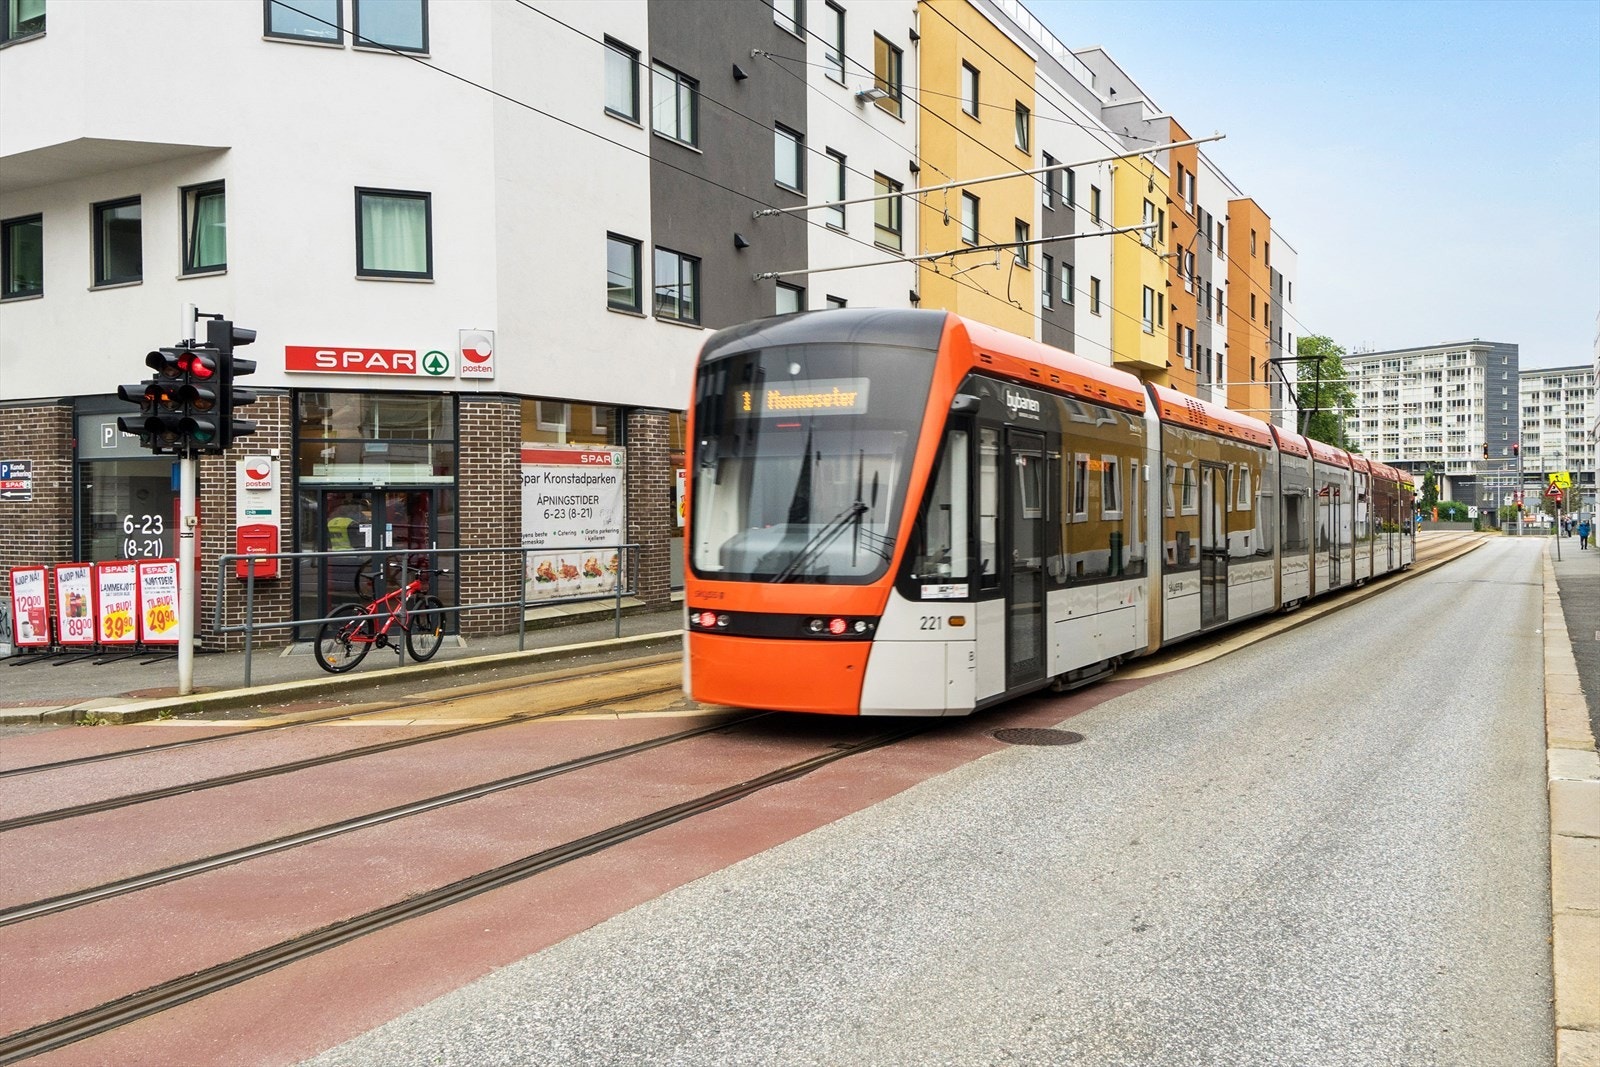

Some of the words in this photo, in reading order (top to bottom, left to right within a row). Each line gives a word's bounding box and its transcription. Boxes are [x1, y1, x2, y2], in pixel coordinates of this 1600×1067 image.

[315, 350, 414, 370] SPAR
[463, 365, 492, 373] posten
[1006, 389, 1040, 412] bybanen
[105, 428, 113, 443] P
[581, 454, 611, 463] SPAR
[2, 464, 8, 478] P
[543, 472, 616, 486] Kronstadparken
[536, 493, 600, 506] ÅPNINGSTIDER
[543, 509, 566, 519] 6-23
[569, 507, 593, 520] (8-21)
[123, 514, 164, 535] 6-23
[123, 538, 163, 558] (8-21)
[105, 566, 128, 574] SPAR
[105, 600, 132, 614] TILBUD!
[147, 595, 174, 609] TILBUD!
[920, 616, 942, 630] 221
